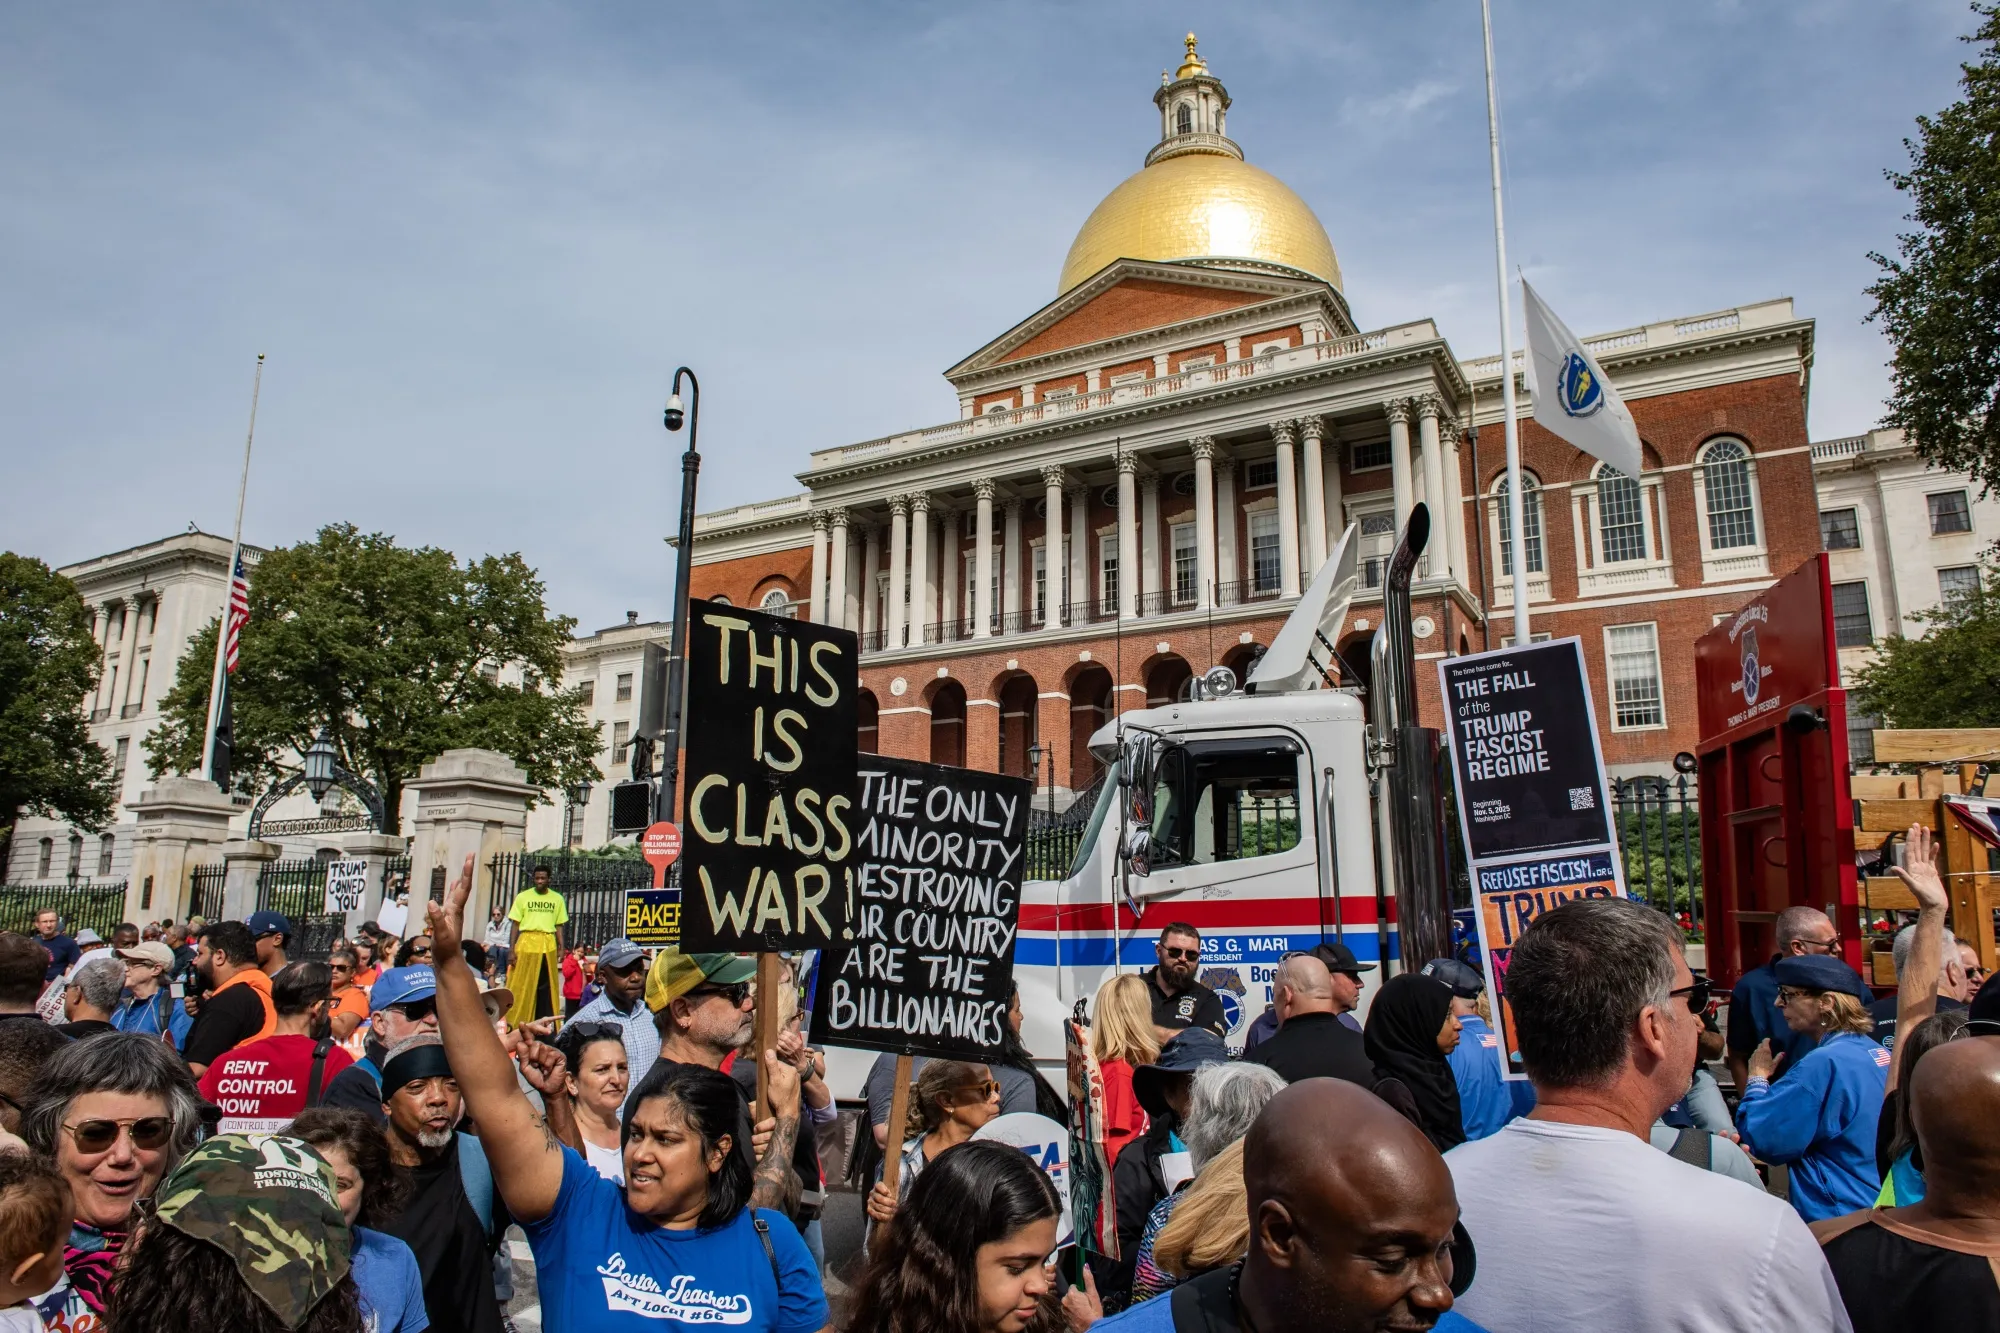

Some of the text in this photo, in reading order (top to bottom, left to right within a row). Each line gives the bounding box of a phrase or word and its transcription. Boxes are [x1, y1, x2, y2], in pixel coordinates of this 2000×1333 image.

[1749, 603, 1761, 621] Local
[1761, 604, 1768, 623] 25
[703, 614, 842, 707] THIS
[1463, 667, 1475, 675] time
[1487, 662, 1502, 671] come
[1455, 670, 1536, 699] THE FALL
[1459, 700, 1490, 716] of the
[1727, 712, 1743, 728] THOMAS
[1747, 704, 1758, 719] MARI
[1757, 695, 1781, 713] PRESIDENT
[1461, 710, 1531, 739] TRUMP
[754, 706, 808, 772] IS
[1465, 729, 1544, 760] FASCIST
[1467, 750, 1551, 781] REGIME
[857, 771, 1017, 838] THE ONLY
[1473, 799, 1501, 809] Beginning
[1473, 807, 1488, 817] Nov.
[1495, 804, 1511, 813] 2025
[341, 818, 367, 829] HOUSE
[690, 773, 851, 862] CLASS
[1474, 812, 1512, 823] Washington DC
[331, 861, 367, 877] TRUMP
[329, 878, 366, 894] CONNED
[858, 862, 1015, 917] ESTROYING
[335, 894, 359, 911] YOU
[699, 864, 854, 940] WAR!
[894, 908, 1017, 959] COUNTRY
[1225, 938, 1242, 952] G.
[1248, 937, 1288, 951] MARI
[841, 942, 990, 996] ARE THE
[1198, 953, 1243, 962] PRESIDENT
[829, 979, 1006, 1047] BILLIONAIRES
[222, 1060, 269, 1076] RENT
[217, 1079, 297, 1095] CONTROL
[216, 1098, 260, 1114] NOW!
[254, 1178, 299, 1189] TRADE
[597, 1252, 739, 1311] Boston Teachers
[611, 1289, 641, 1307] AFT
[690, 1309, 724, 1321] #66
